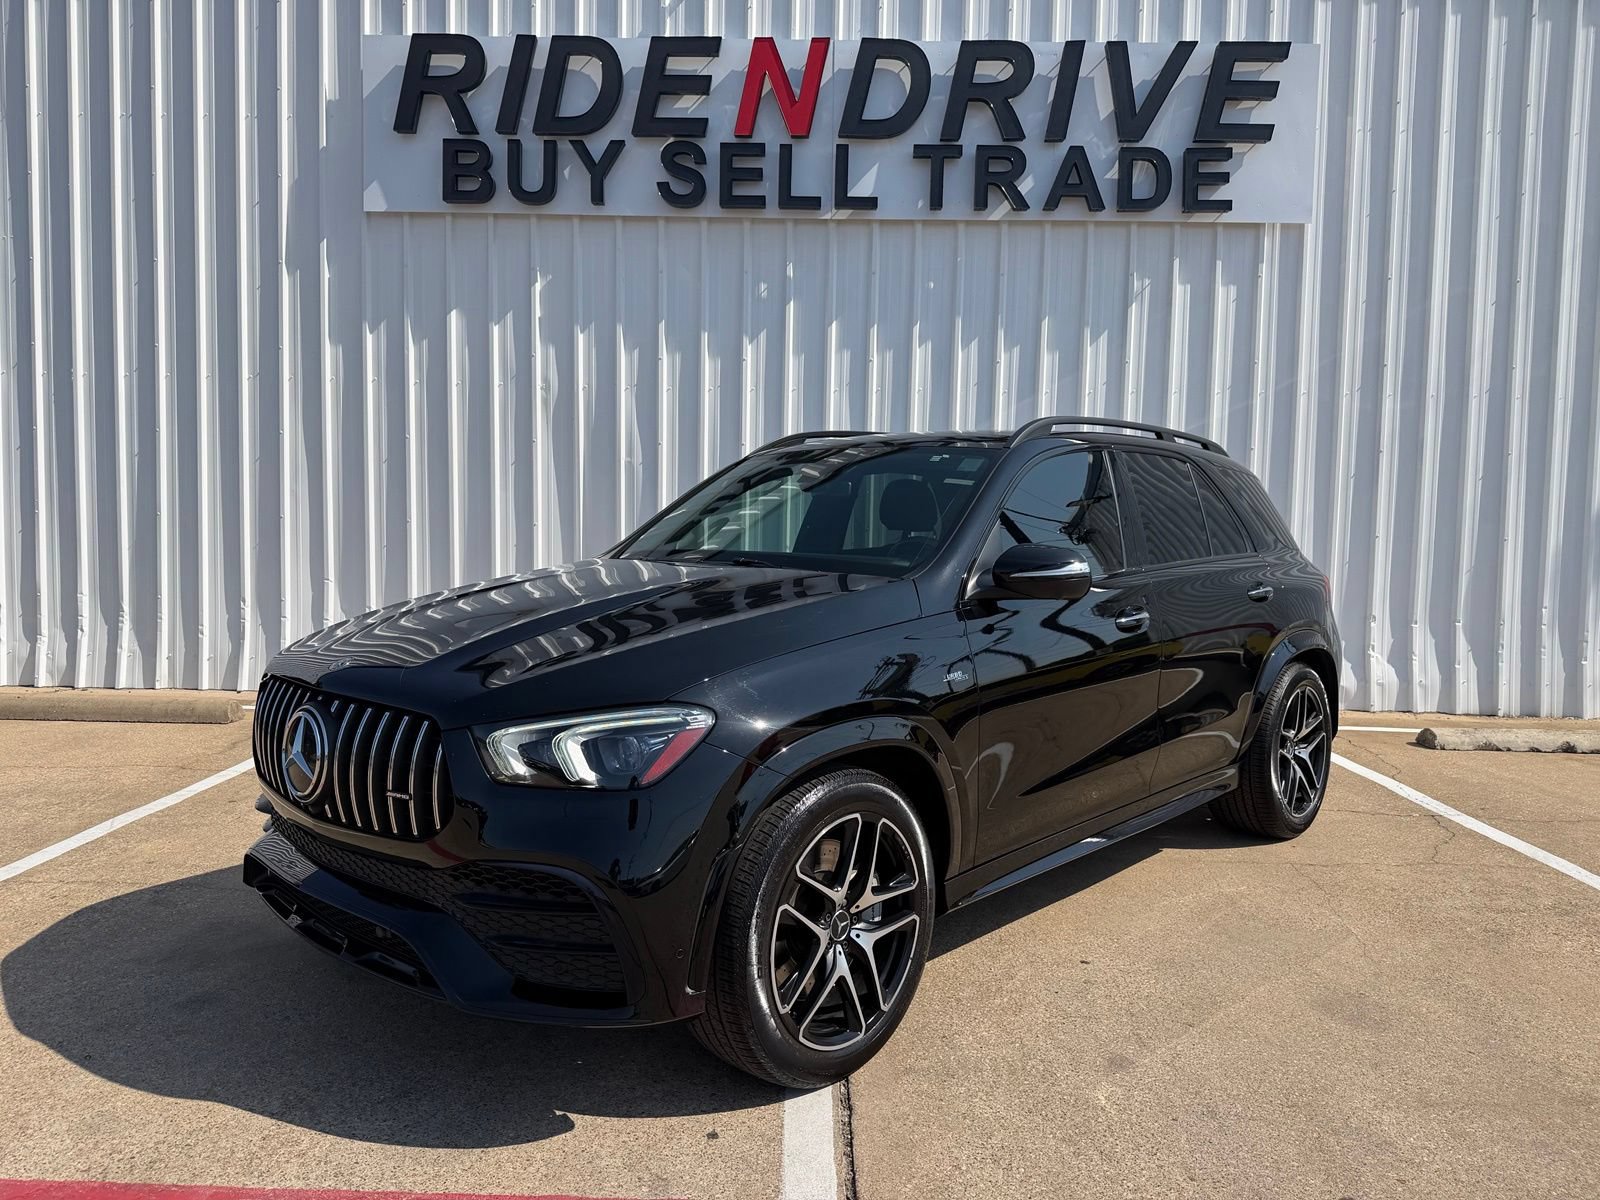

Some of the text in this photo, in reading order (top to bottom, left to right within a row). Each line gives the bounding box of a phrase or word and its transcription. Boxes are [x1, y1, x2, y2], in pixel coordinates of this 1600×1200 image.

[442, 138, 1233, 213] BUY SELL TRADE
